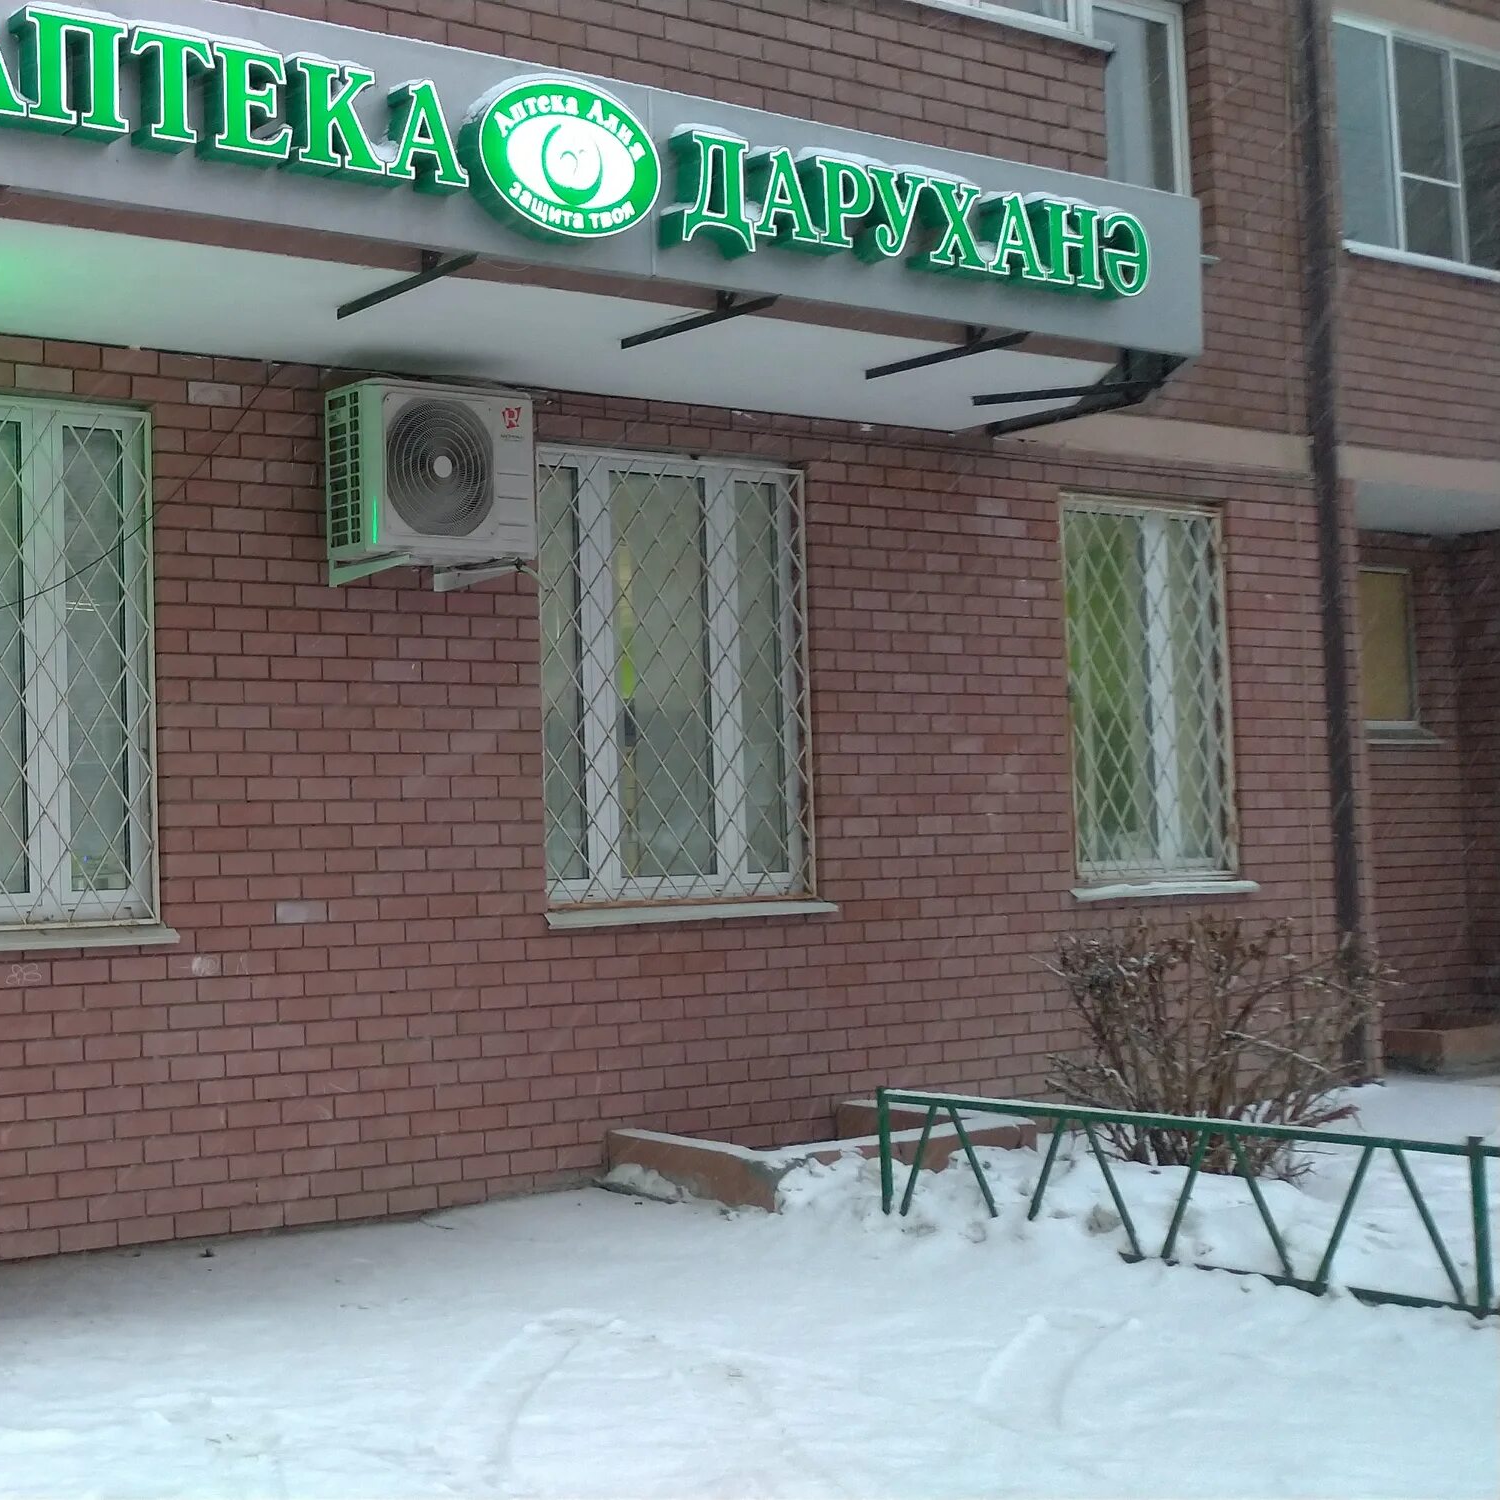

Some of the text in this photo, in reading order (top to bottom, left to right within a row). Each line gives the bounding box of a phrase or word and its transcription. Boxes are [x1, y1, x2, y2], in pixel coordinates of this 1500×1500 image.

[493, 94, 647, 163] Аптека Алия
[682, 130, 1152, 297] ДАРУХАНӘ
